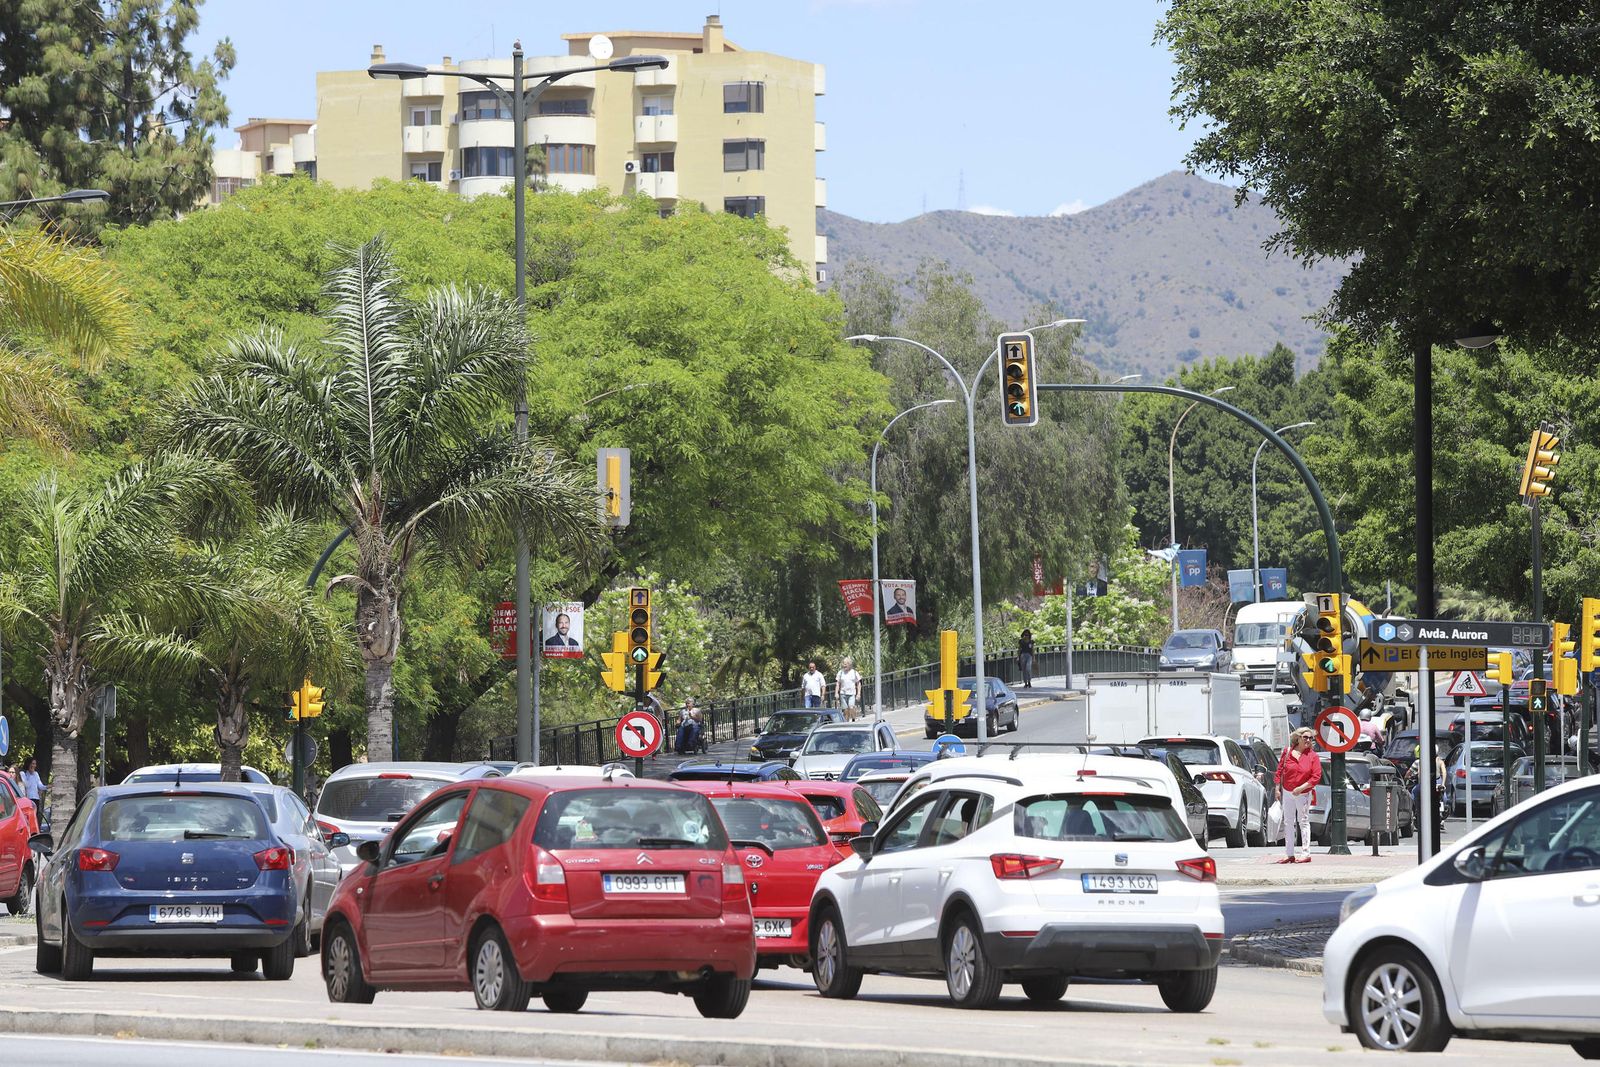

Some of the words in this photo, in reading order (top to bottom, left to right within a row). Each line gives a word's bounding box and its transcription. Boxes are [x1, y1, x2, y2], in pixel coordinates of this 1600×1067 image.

[1418, 628, 1449, 639] Avda.
[1452, 628, 1488, 640] Aurora
[1401, 650, 1412, 660] El
[1450, 649, 1485, 661] Inglés
[615, 876, 649, 890] 0993
[655, 876, 678, 890] GTT
[1092, 875, 1125, 889] 1493
[1129, 876, 1154, 889] KGX
[159, 906, 192, 918] 6786
[197, 906, 220, 918] JXH
[764, 920, 786, 933] GXK
